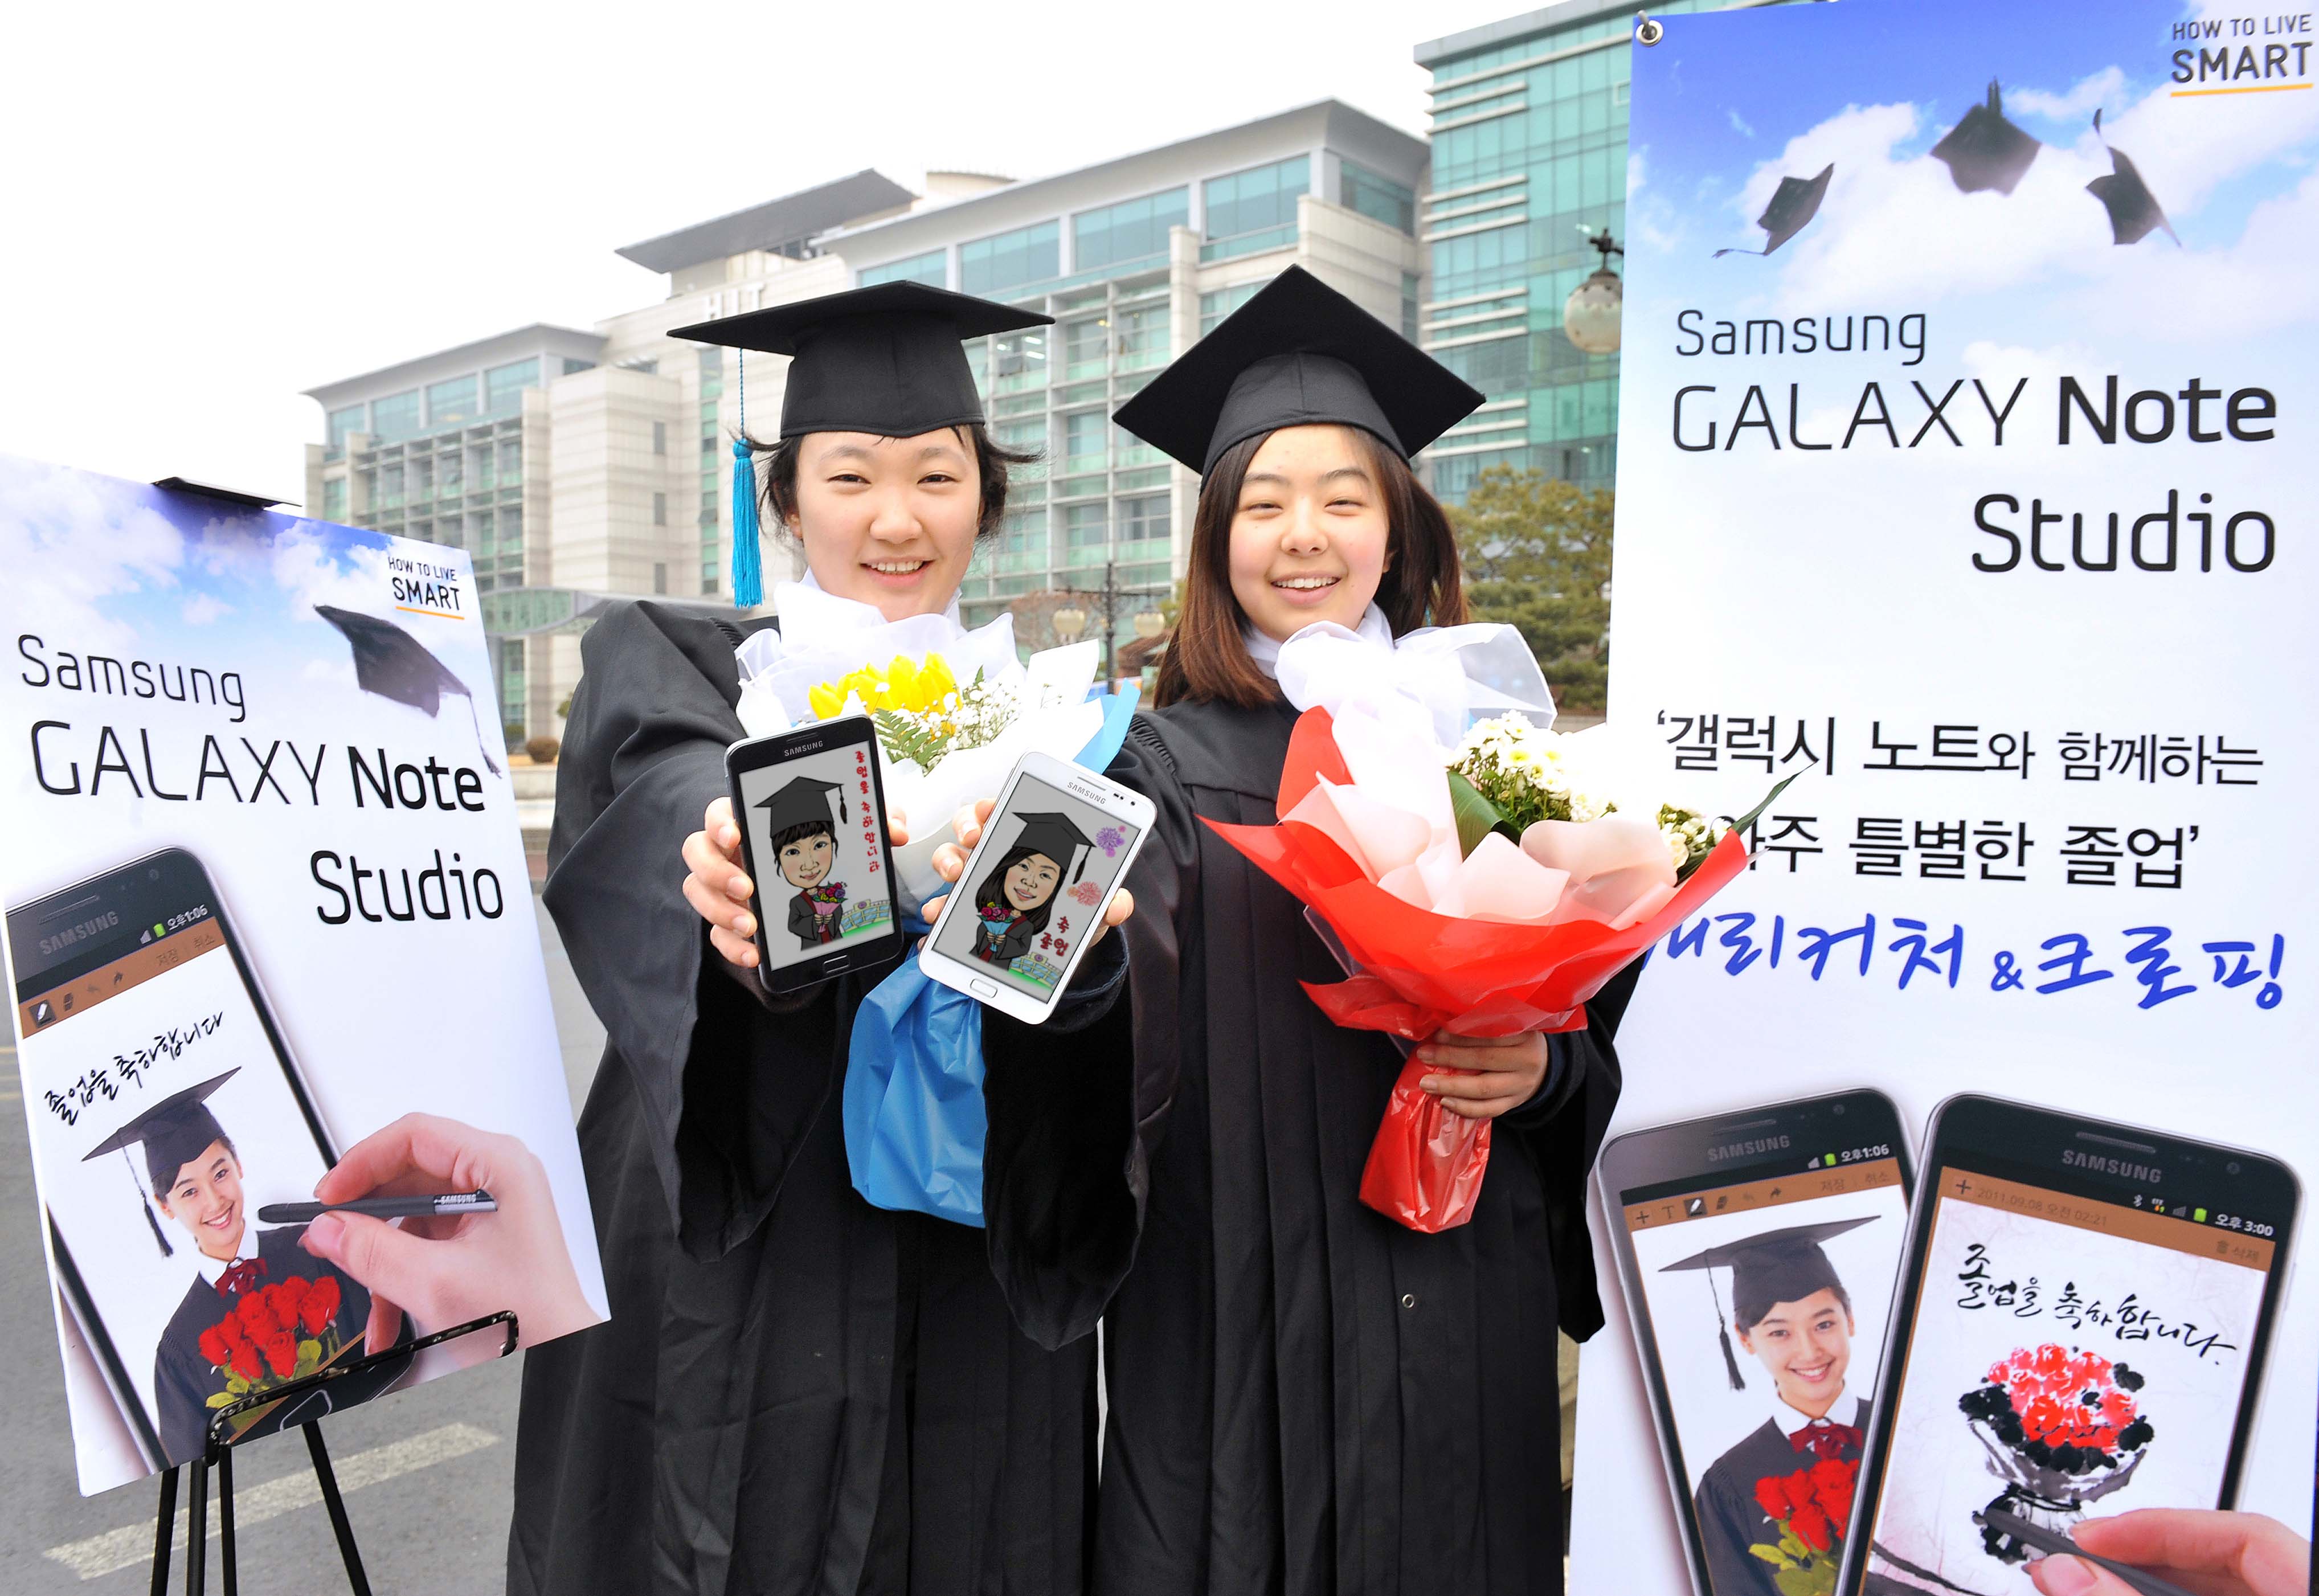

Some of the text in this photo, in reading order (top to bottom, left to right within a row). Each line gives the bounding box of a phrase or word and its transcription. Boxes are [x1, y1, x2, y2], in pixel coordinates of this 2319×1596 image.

[2173, 13, 2313, 40] HOW TO LIVE
[2171, 41, 2313, 83] SMART
[1676, 309, 1926, 367] Samsung
[1672, 375, 2277, 452] GALAXY Note
[1972, 488, 2275, 574] Studio
[387, 556, 457, 582] HOW TO LIVE
[392, 576, 460, 611] SMART
[18, 633, 246, 723] Samsung
[30, 720, 485, 812] GALAXY Note
[784, 740, 824, 756] SAMSUNG
[1863, 721, 2036, 780] 노트와
[2058, 731, 2264, 785] 함께하는
[1067, 781, 1107, 805] SAMSUNG
[861, 801, 880, 873] 축하합니다
[310, 848, 504, 926] Studio
[39, 911, 119, 955] SAMSUNG
[1040, 932, 1069, 957] 졸업
[1057, 916, 1070, 933] 축
[1990, 950, 2025, 992] &
[2035, 926, 2285, 1010] 크로핑
[1707, 1135, 1791, 1162] SAMSUNG
[2062, 1149, 2162, 1184] SAMSUNG
[2243, 1220, 2275, 1237] 3:00
[1957, 1242, 2043, 1318] 졸업을
